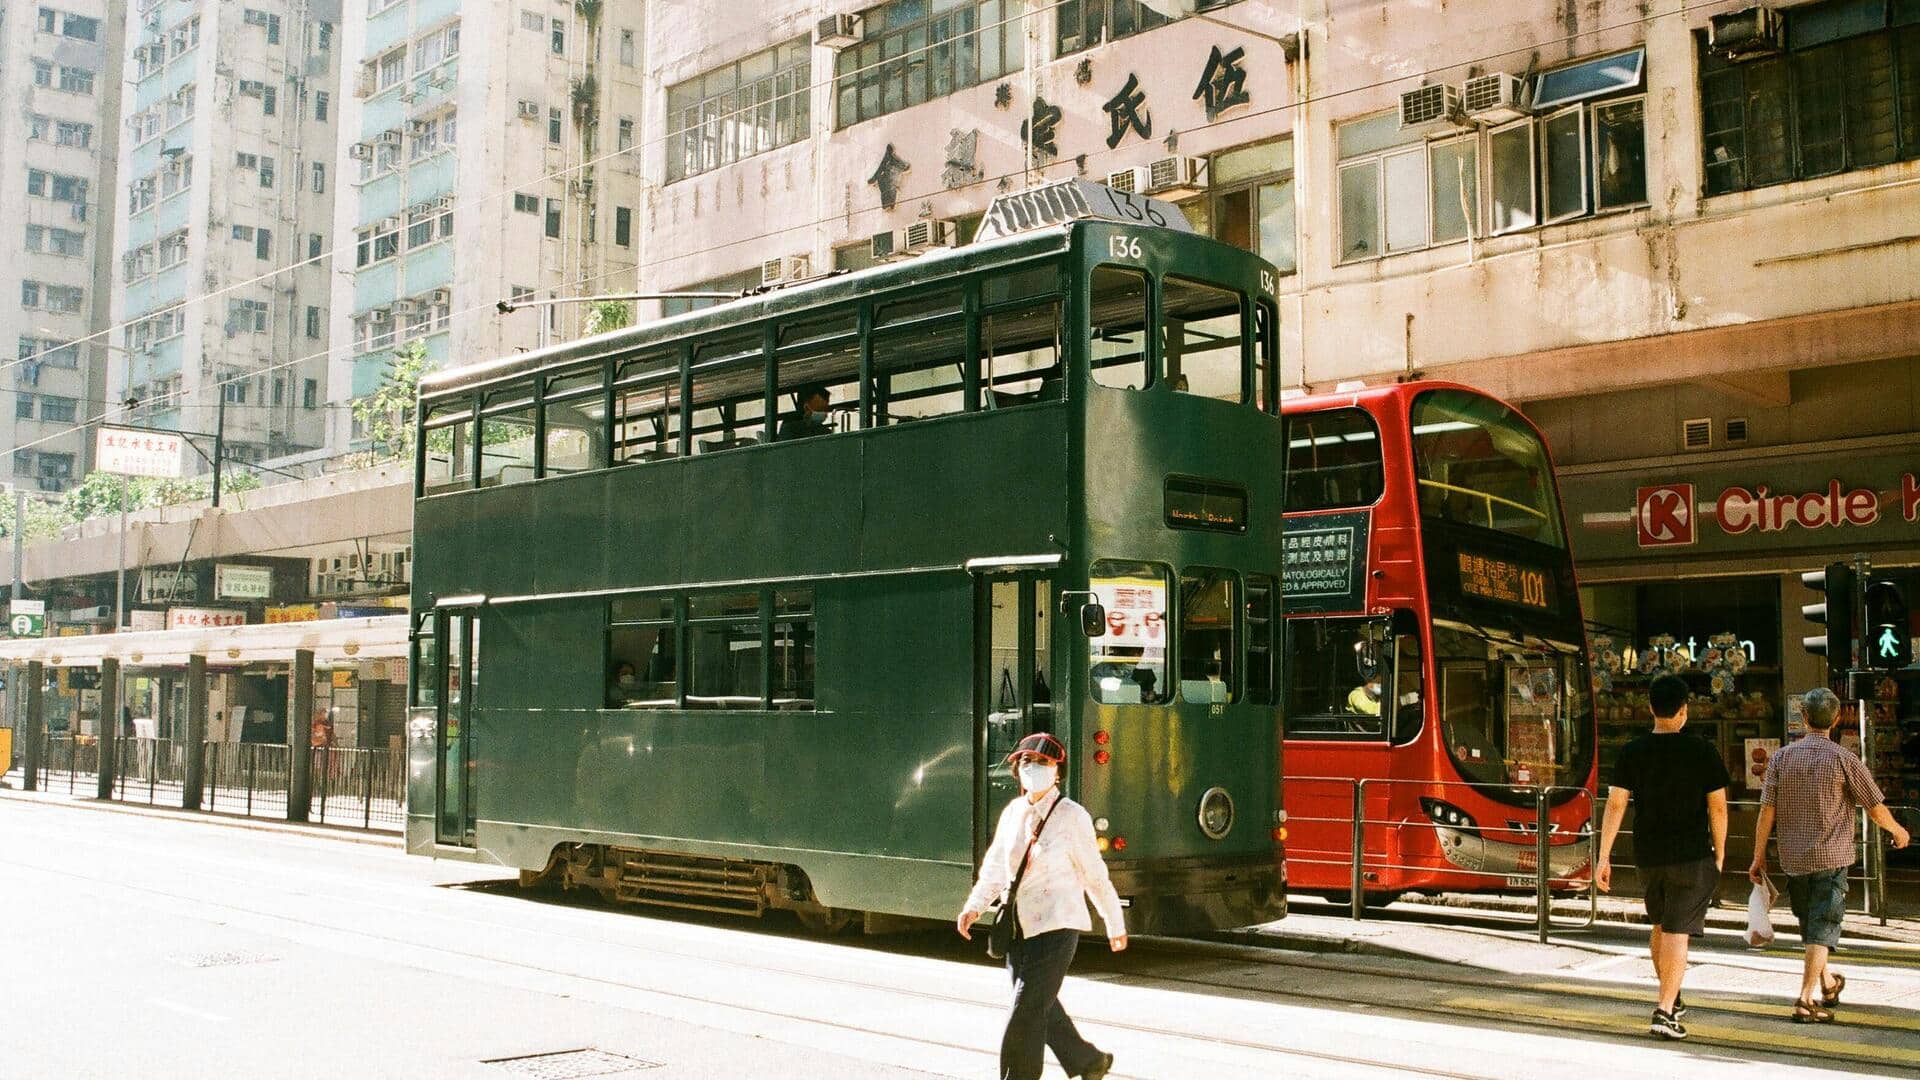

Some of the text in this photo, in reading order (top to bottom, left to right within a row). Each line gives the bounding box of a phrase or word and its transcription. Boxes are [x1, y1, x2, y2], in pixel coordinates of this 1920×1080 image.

[1105, 187, 1167, 228] 136
[1108, 234, 1142, 259] 136
[1259, 269, 1275, 296] 136
[1716, 479, 1879, 535] Circle
[1301, 579, 1346, 591] APPROVED
[1521, 569, 1547, 608] 101
[1211, 704, 1223, 714] 051
